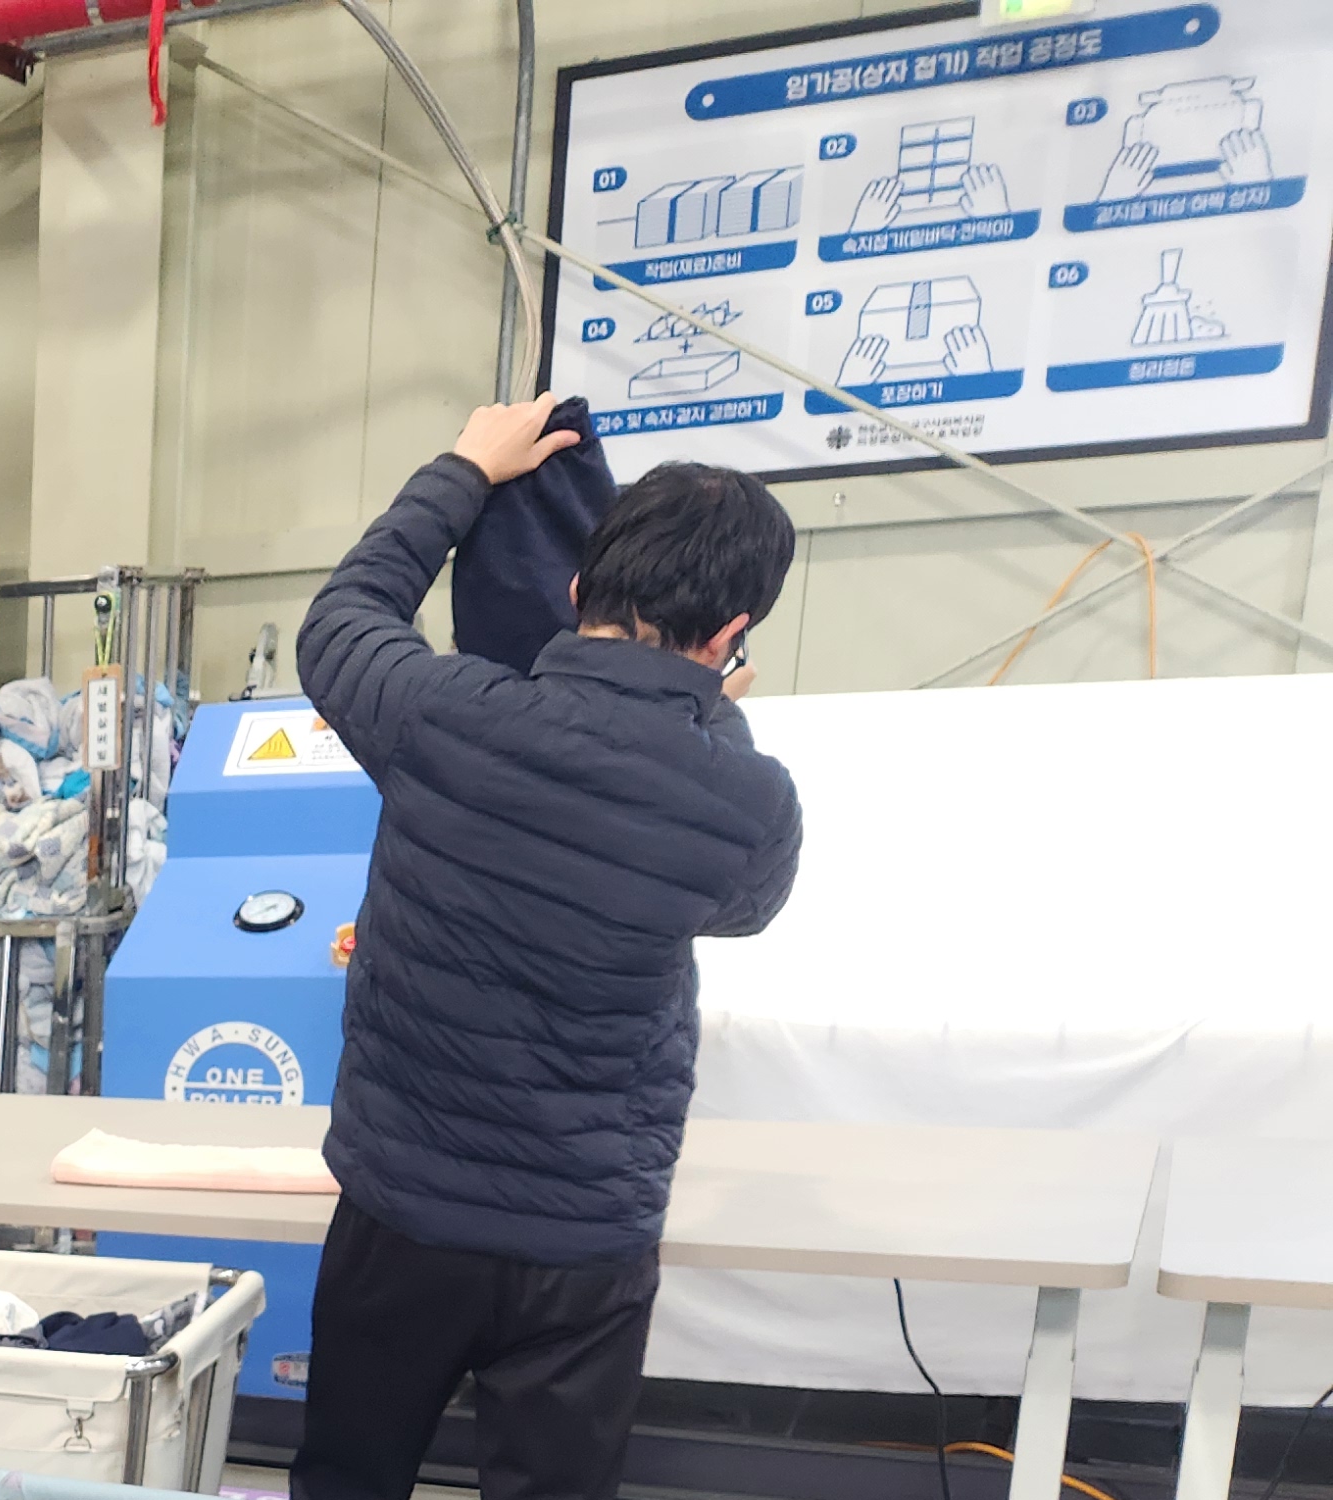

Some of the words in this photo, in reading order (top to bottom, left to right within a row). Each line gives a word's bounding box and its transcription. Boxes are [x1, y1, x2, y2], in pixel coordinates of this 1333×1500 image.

[913, 51, 969, 81] 접기)
[975, 41, 1023, 69] 작업
[1028, 29, 1103, 63] 공정도
[1073, 101, 1097, 121] 03
[825, 137, 847, 156] 02
[599, 171, 617, 189] 01
[1055, 266, 1079, 284] 06
[811, 294, 834, 312] 05
[587, 321, 609, 338] 04
[1128, 356, 1197, 382] 정리정돈
[880, 381, 943, 404] 포장하기
[627, 413, 642, 430] 및
[206, 1067, 265, 1085] ONE
